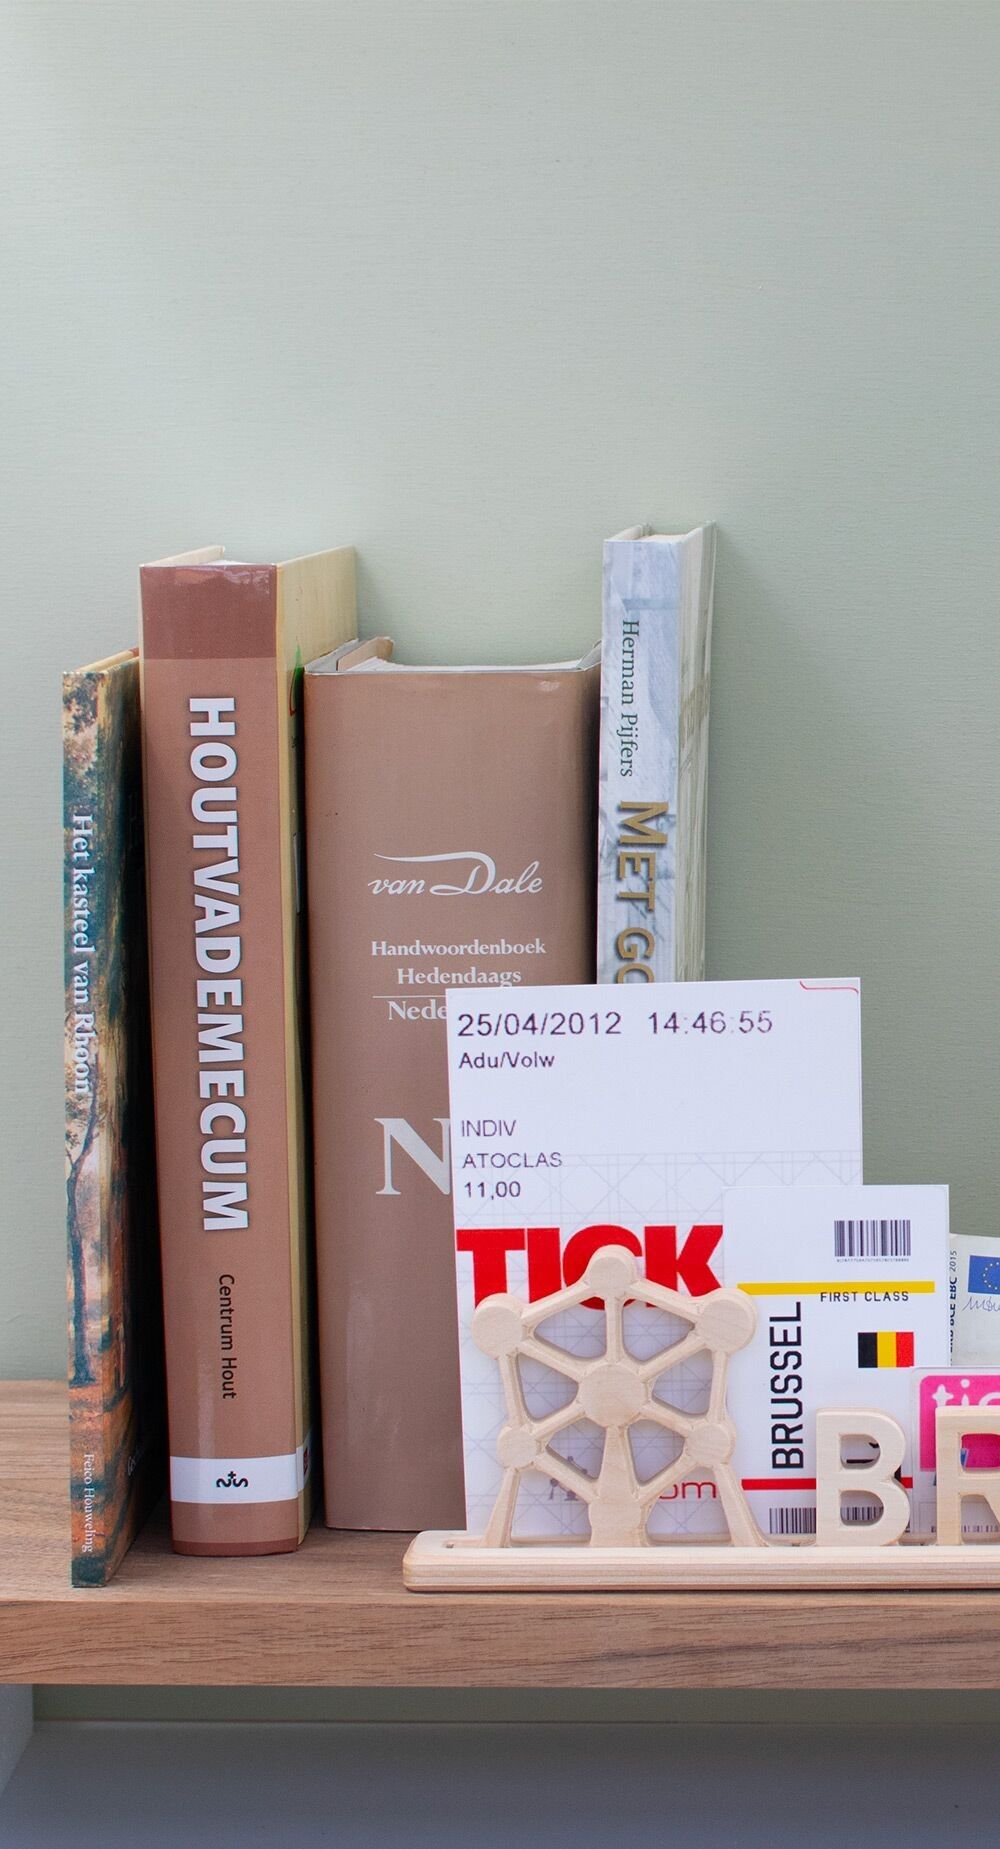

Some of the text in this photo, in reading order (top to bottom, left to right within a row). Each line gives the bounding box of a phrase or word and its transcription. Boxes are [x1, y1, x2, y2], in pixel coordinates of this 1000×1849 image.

[619, 620, 640, 778] Herman Pijfers
[367, 851, 543, 896] van Dale
[617, 801, 669, 912] MET
[72, 813, 96, 1095] Het kasteel van Rhoon
[188, 696, 249, 1232] HOUTVADEMECUM
[371, 938, 547, 956] Handwoordenboek
[397, 967, 522, 988] Hedendaags
[457, 1009, 774, 1037] 25/04/2012 14:46:55
[458, 1050, 556, 1070] Adu/Volw
[461, 1119, 517, 1138] INDIV
[374, 1118, 450, 1195] N
[462, 1152, 563, 1170] ATOCLAS
[464, 1180, 522, 1200] 11,00
[820, 1290, 910, 1303] FIRST CLASS
[218, 1273, 238, 1400] Centrum Hout
[769, 1301, 804, 1469] BRUSSEL
[81, 1453, 97, 1553] Feico Houweling
